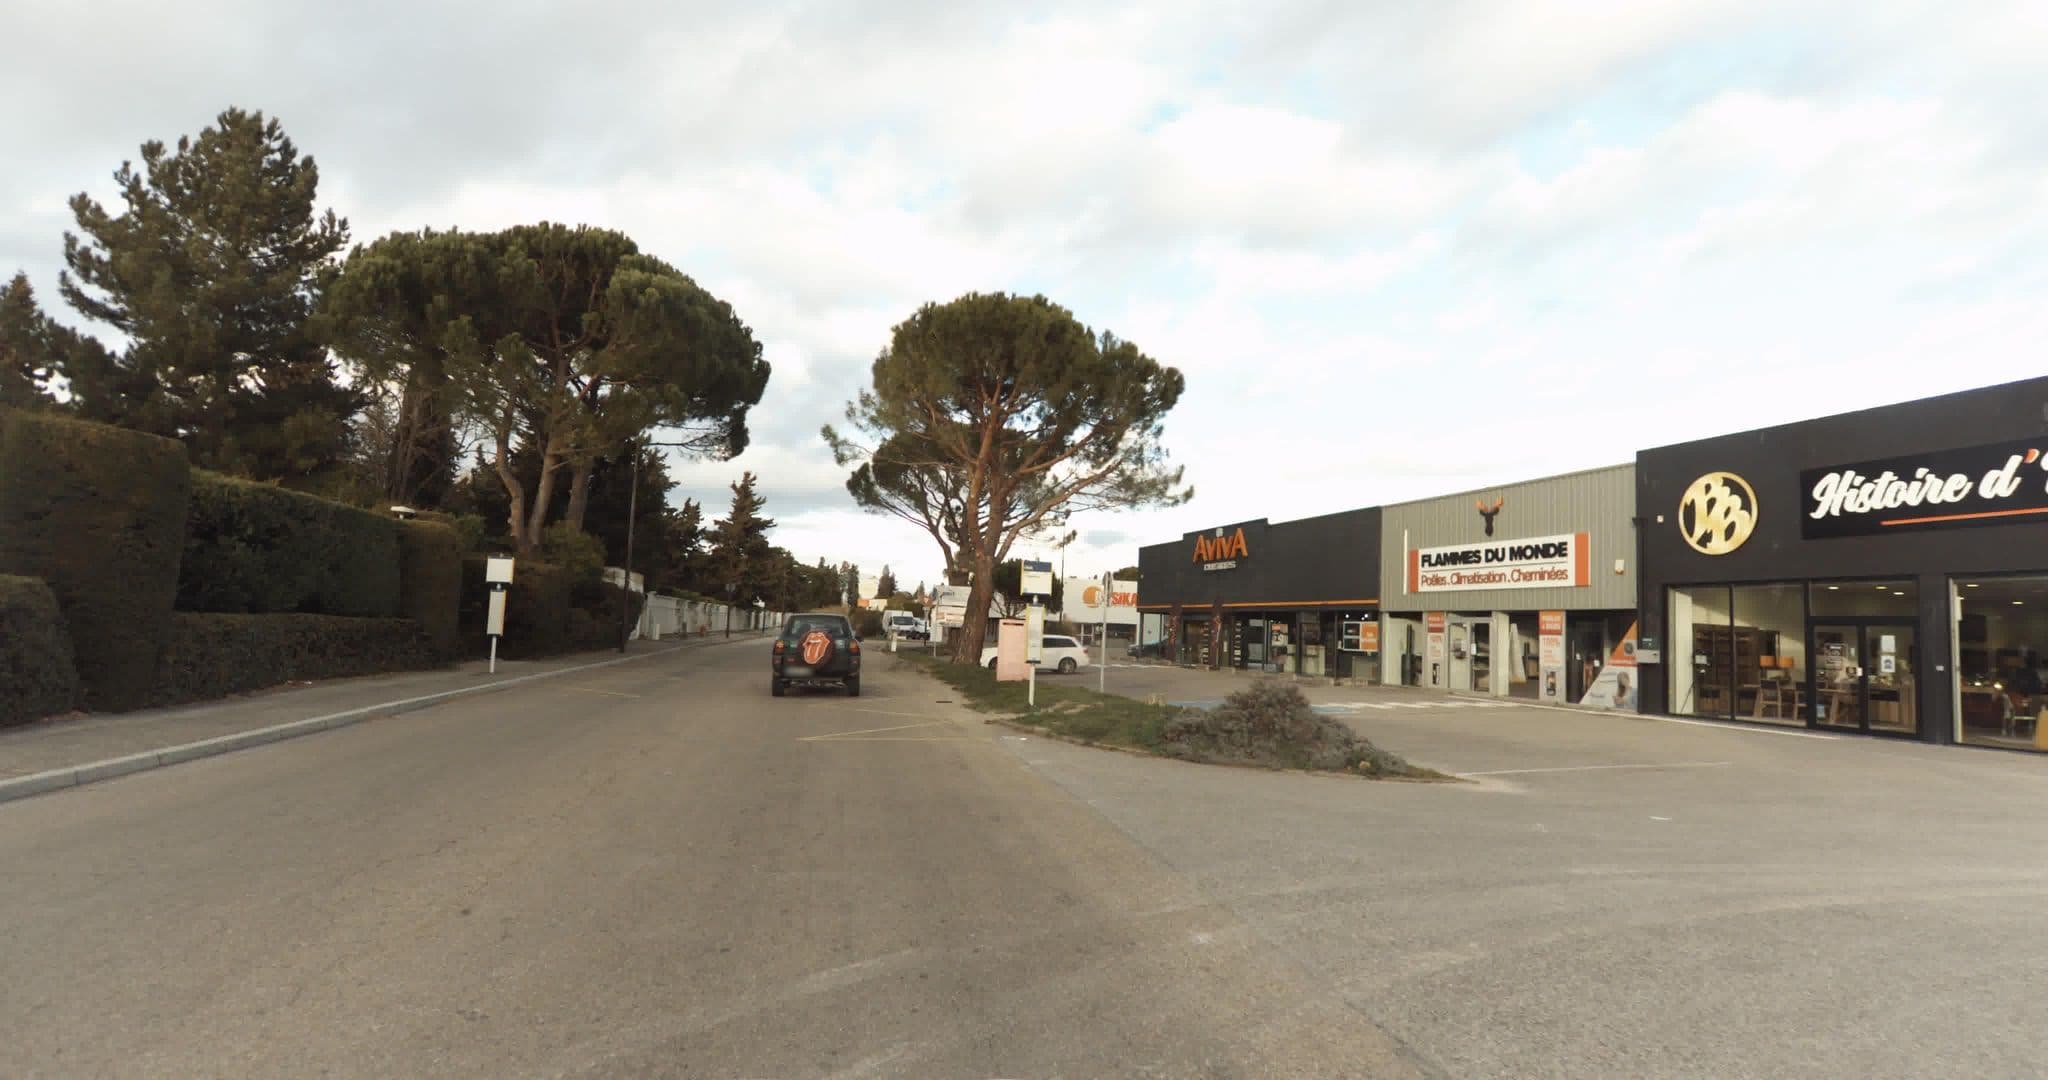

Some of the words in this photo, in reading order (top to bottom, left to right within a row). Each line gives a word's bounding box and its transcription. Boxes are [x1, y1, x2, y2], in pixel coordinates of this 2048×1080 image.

[1809, 467, 1973, 519] Histoire
[1978, 448, 2048, 499] d'
[1421, 549, 1482, 568] FLAMMES
[1485, 546, 1505, 563] DU
[1509, 541, 1568, 561] MONDE
[1511, 566, 1569, 582] Cheminées
